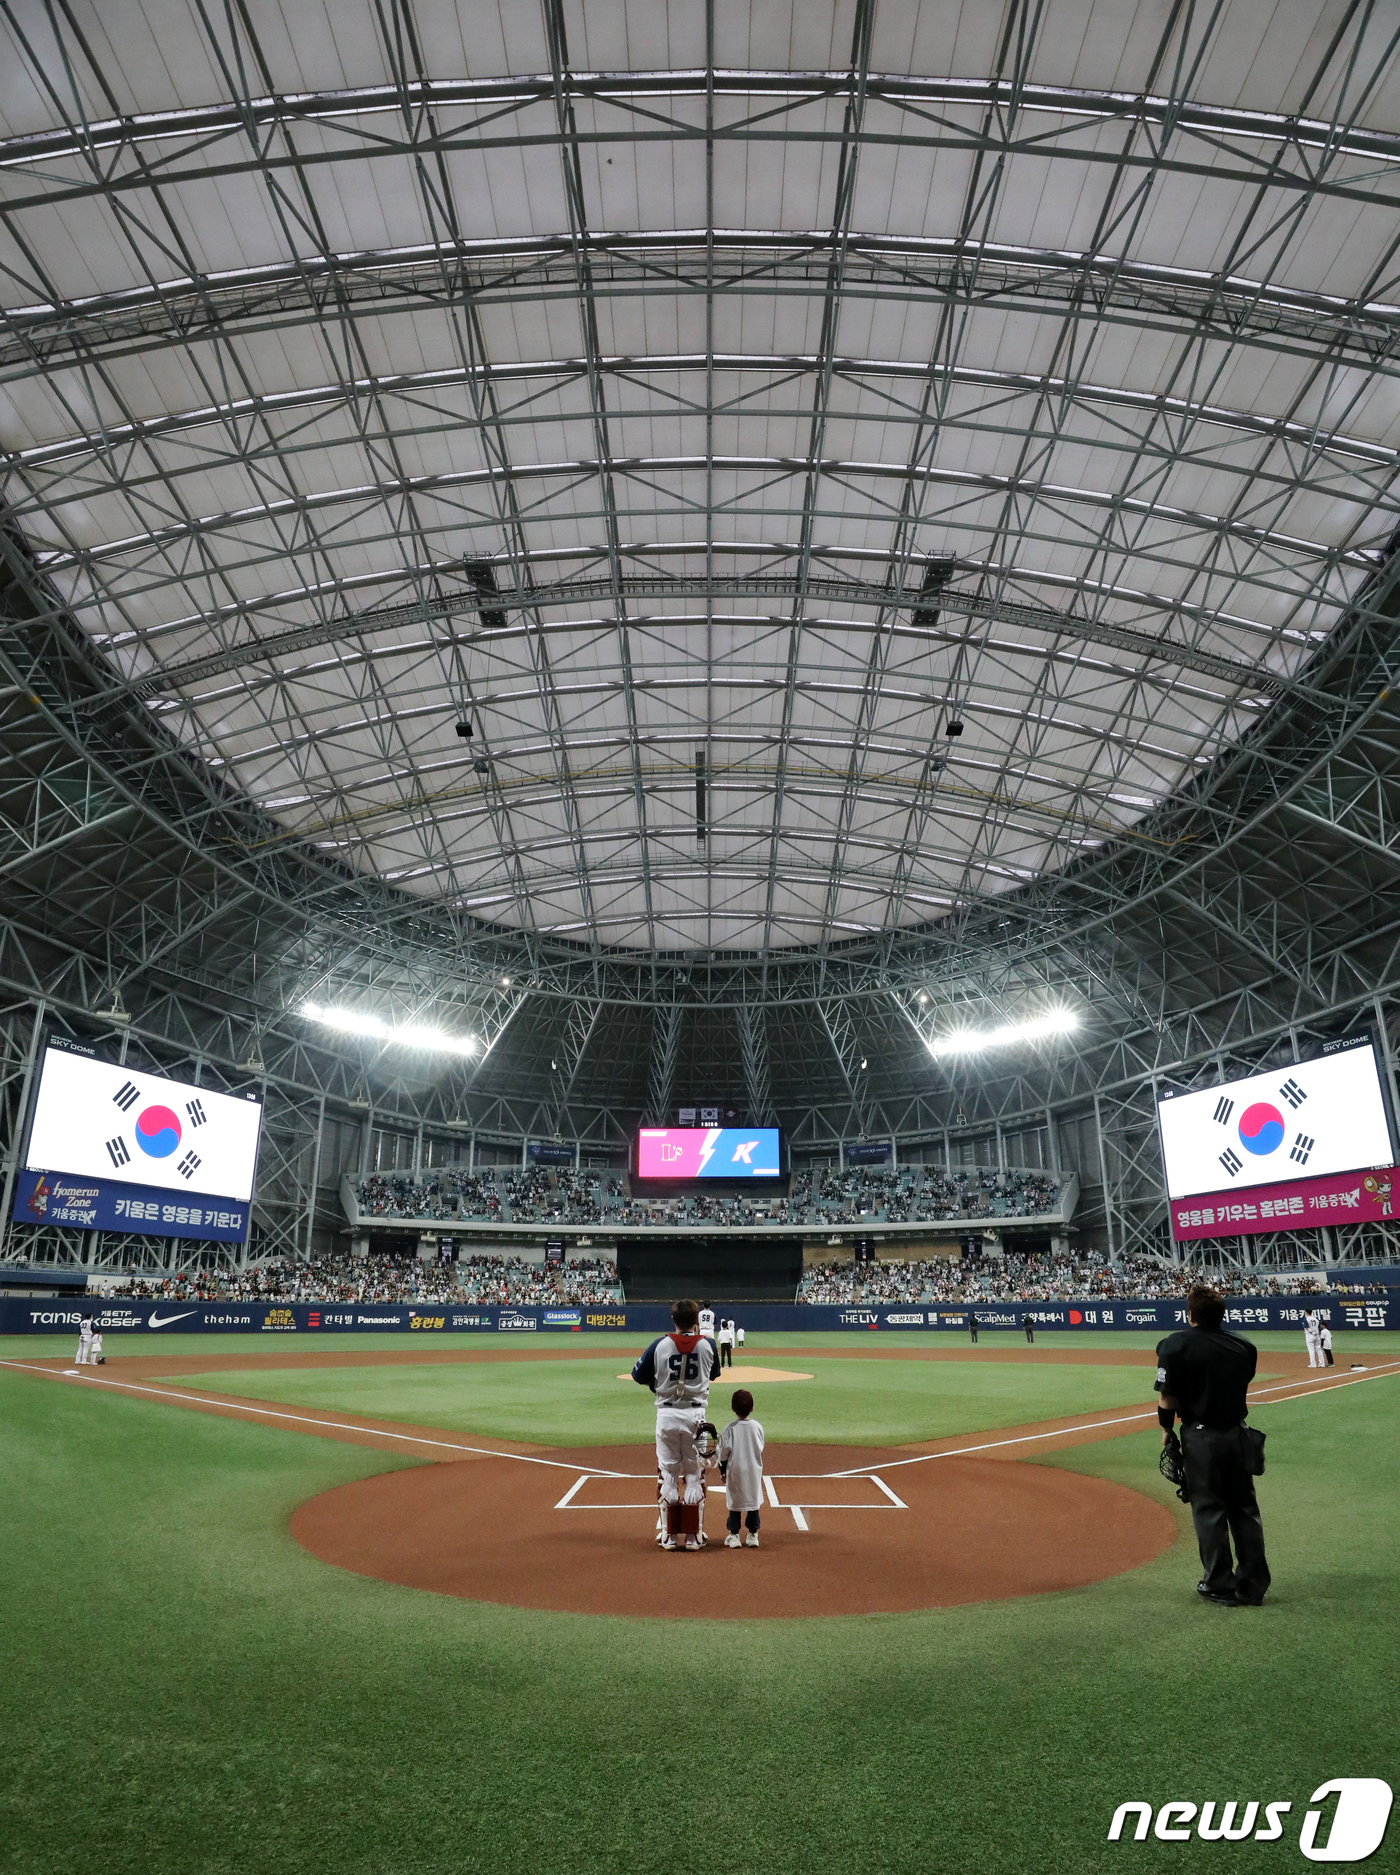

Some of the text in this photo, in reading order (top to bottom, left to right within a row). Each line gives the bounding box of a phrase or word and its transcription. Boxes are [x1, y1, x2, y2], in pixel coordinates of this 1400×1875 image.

[50, 1038, 95, 1055] SKY DOME
[1323, 1035, 1369, 1052] SKY DOME
[52, 1181, 99, 1198] Homerun
[65, 1196, 91, 1207] Zone
[1309, 1193, 1348, 1208] 키움증권
[51, 1207, 86, 1222] 키움증권
[115, 1199, 242, 1229] 키움은 영웅을 키운다
[1177, 1197, 1304, 1227] 영웅을 키우는 홈런존
[93, 1317, 142, 1327] KOSEF
[204, 1315, 250, 1324] theham
[357, 1316, 400, 1324] Panasonic
[452, 1317, 480, 1326] 김안과병원
[586, 1314, 625, 1326] 대방건설
[702, 1314, 711, 1322] 58
[839, 1314, 878, 1323] THE LIV
[974, 1314, 1016, 1323] ScalpMed
[1126, 1313, 1158, 1324] Orgain
[1345, 1307, 1387, 1327] 쿠팝
[669, 1353, 699, 1380] 56
